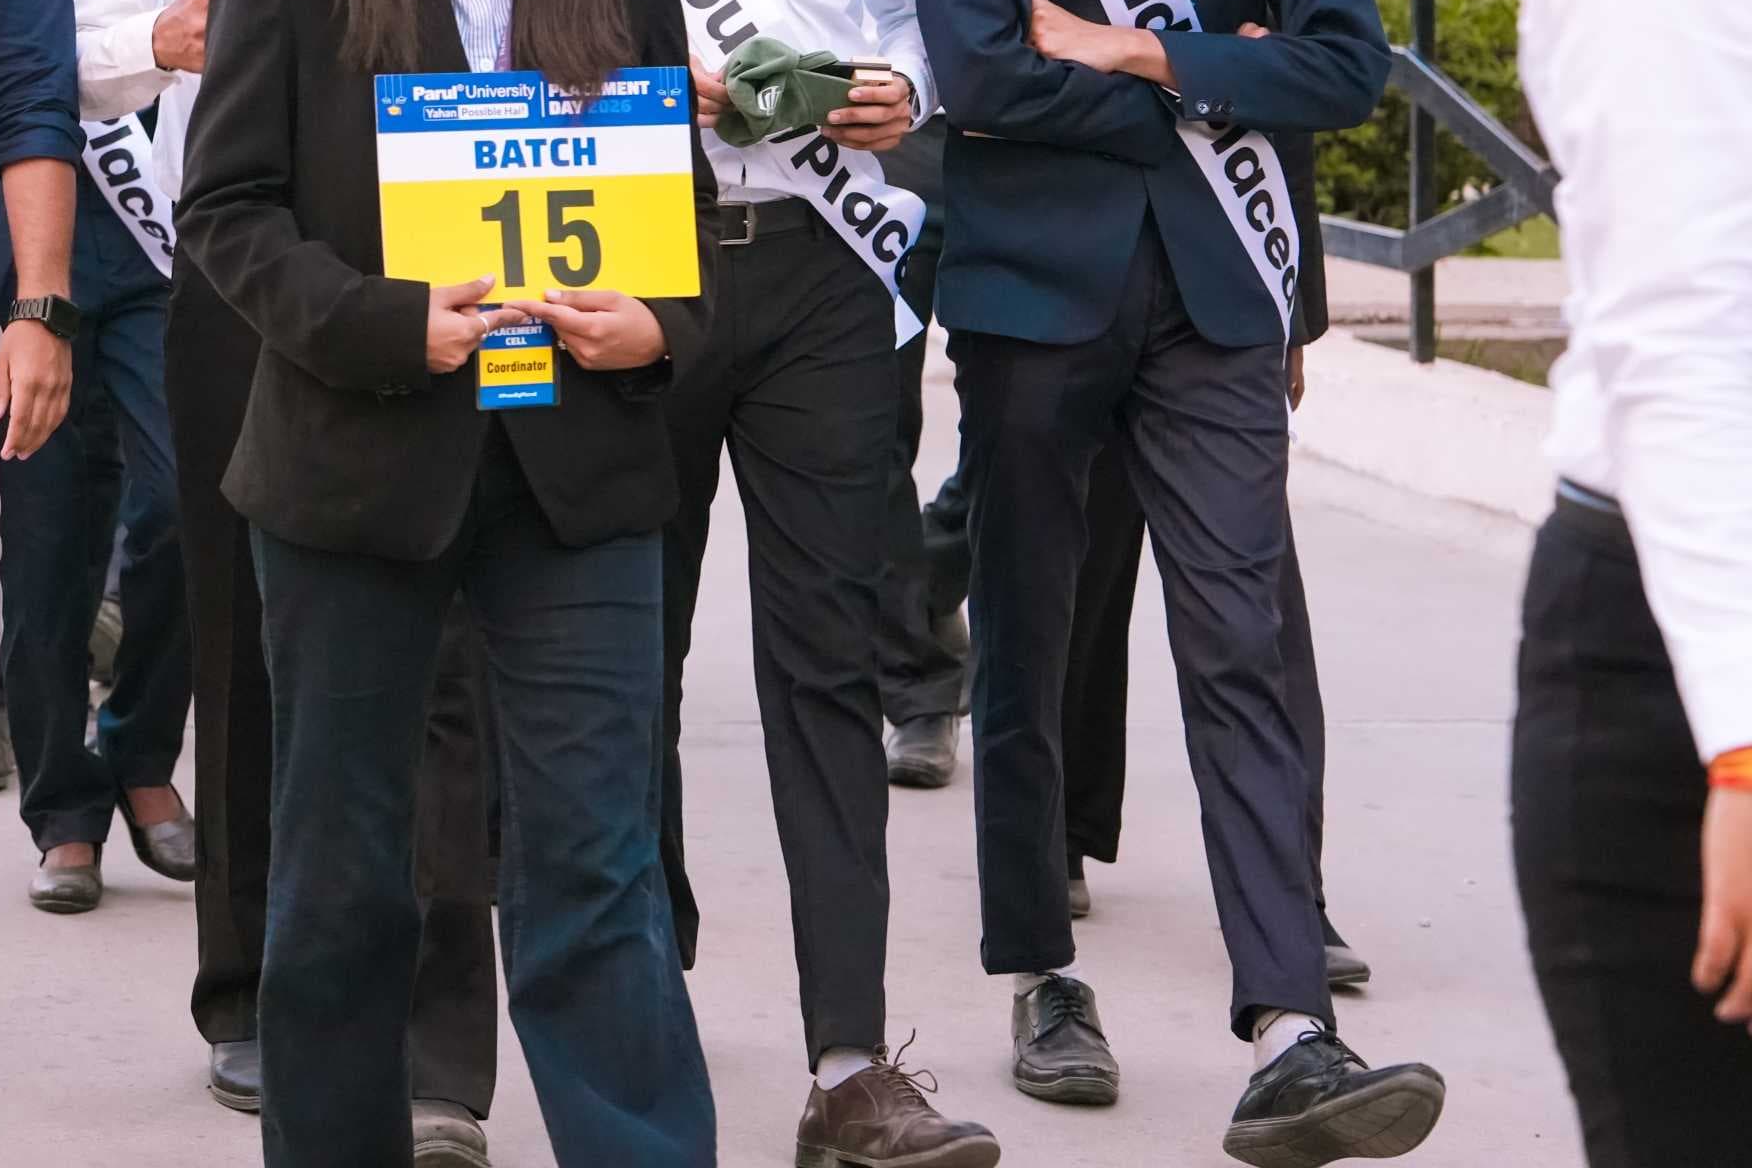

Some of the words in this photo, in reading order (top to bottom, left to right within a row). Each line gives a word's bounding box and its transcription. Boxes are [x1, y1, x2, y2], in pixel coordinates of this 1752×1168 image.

[465, 83, 536, 100] University
[425, 108, 457, 119] Yahan
[549, 100, 583, 115] DAY
[588, 99, 632, 114] 2026
[474, 137, 596, 169] BATCH
[481, 189, 602, 289] 15
[505, 336, 527, 346] CELL
[487, 360, 548, 374] Coordinator
